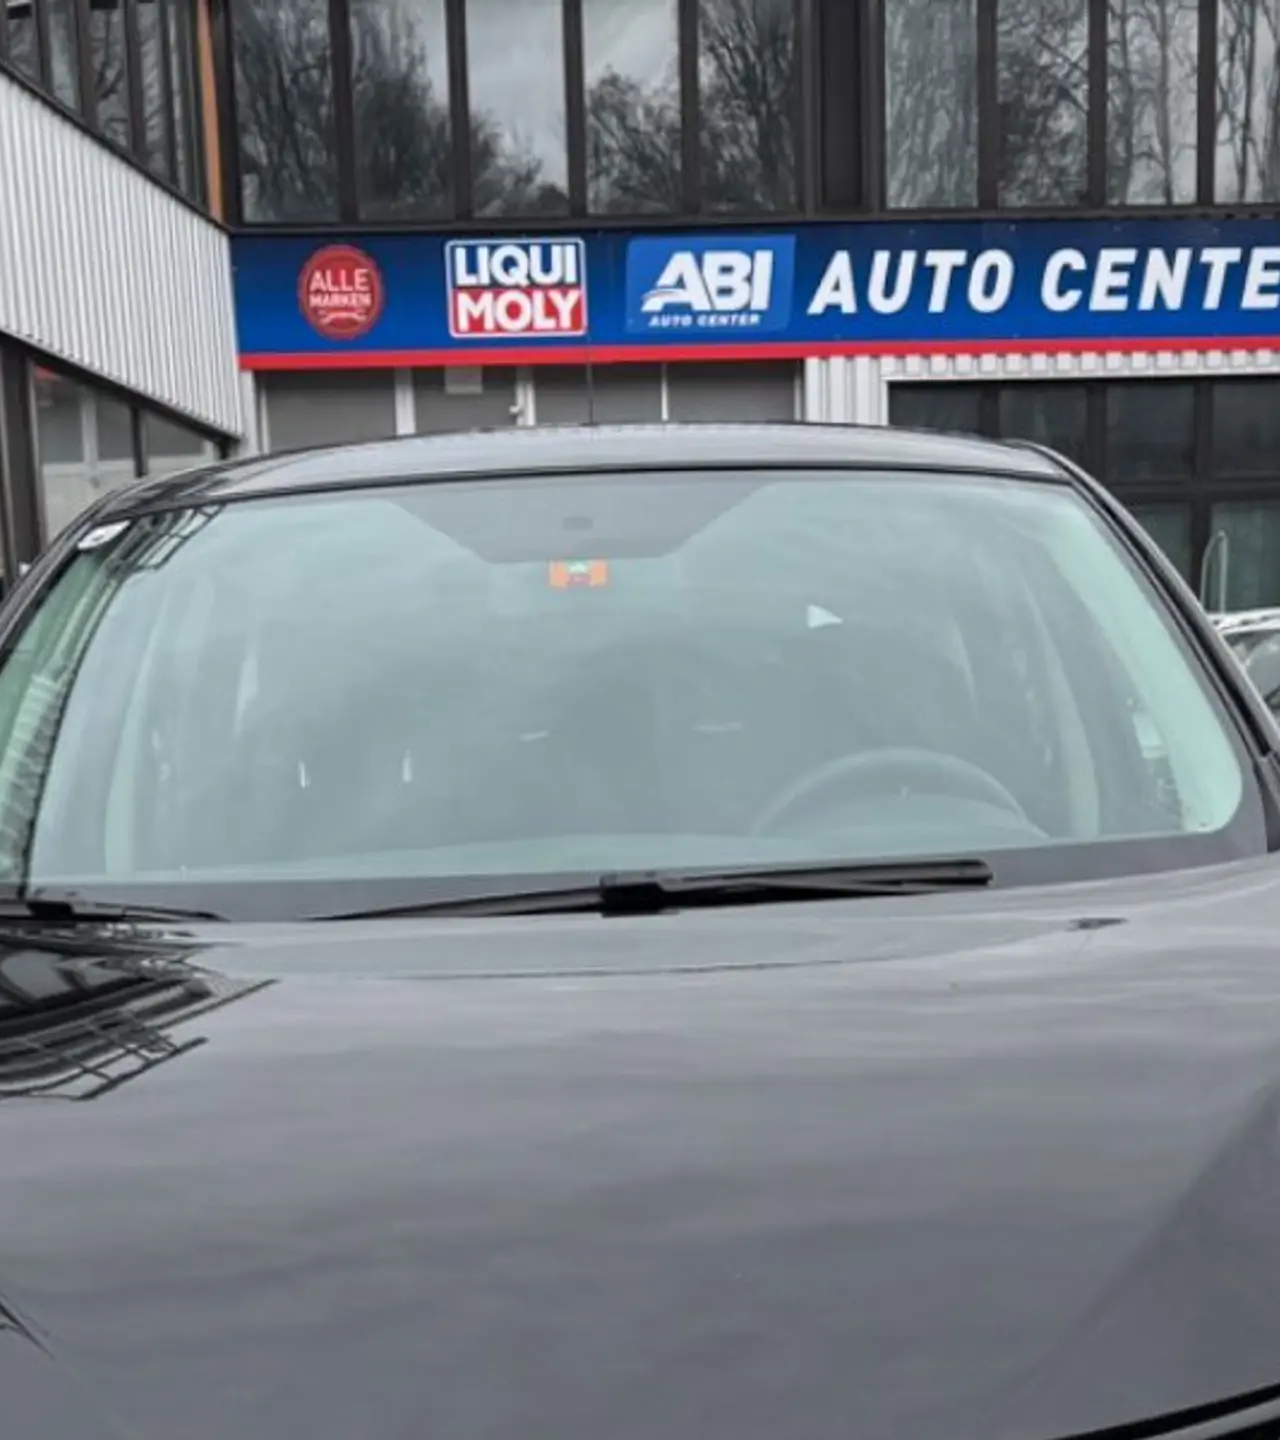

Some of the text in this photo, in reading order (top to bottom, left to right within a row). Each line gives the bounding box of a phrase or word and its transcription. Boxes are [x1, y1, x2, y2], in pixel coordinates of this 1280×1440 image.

[309, 268, 369, 292] ALLE
[454, 245, 578, 287] LIQUI
[641, 250, 774, 313] ABI
[807, 249, 1015, 315] AUTO
[309, 290, 371, 309] MARKEN
[456, 289, 582, 331] MOLY
[648, 313, 762, 328] AUTO CENTER
